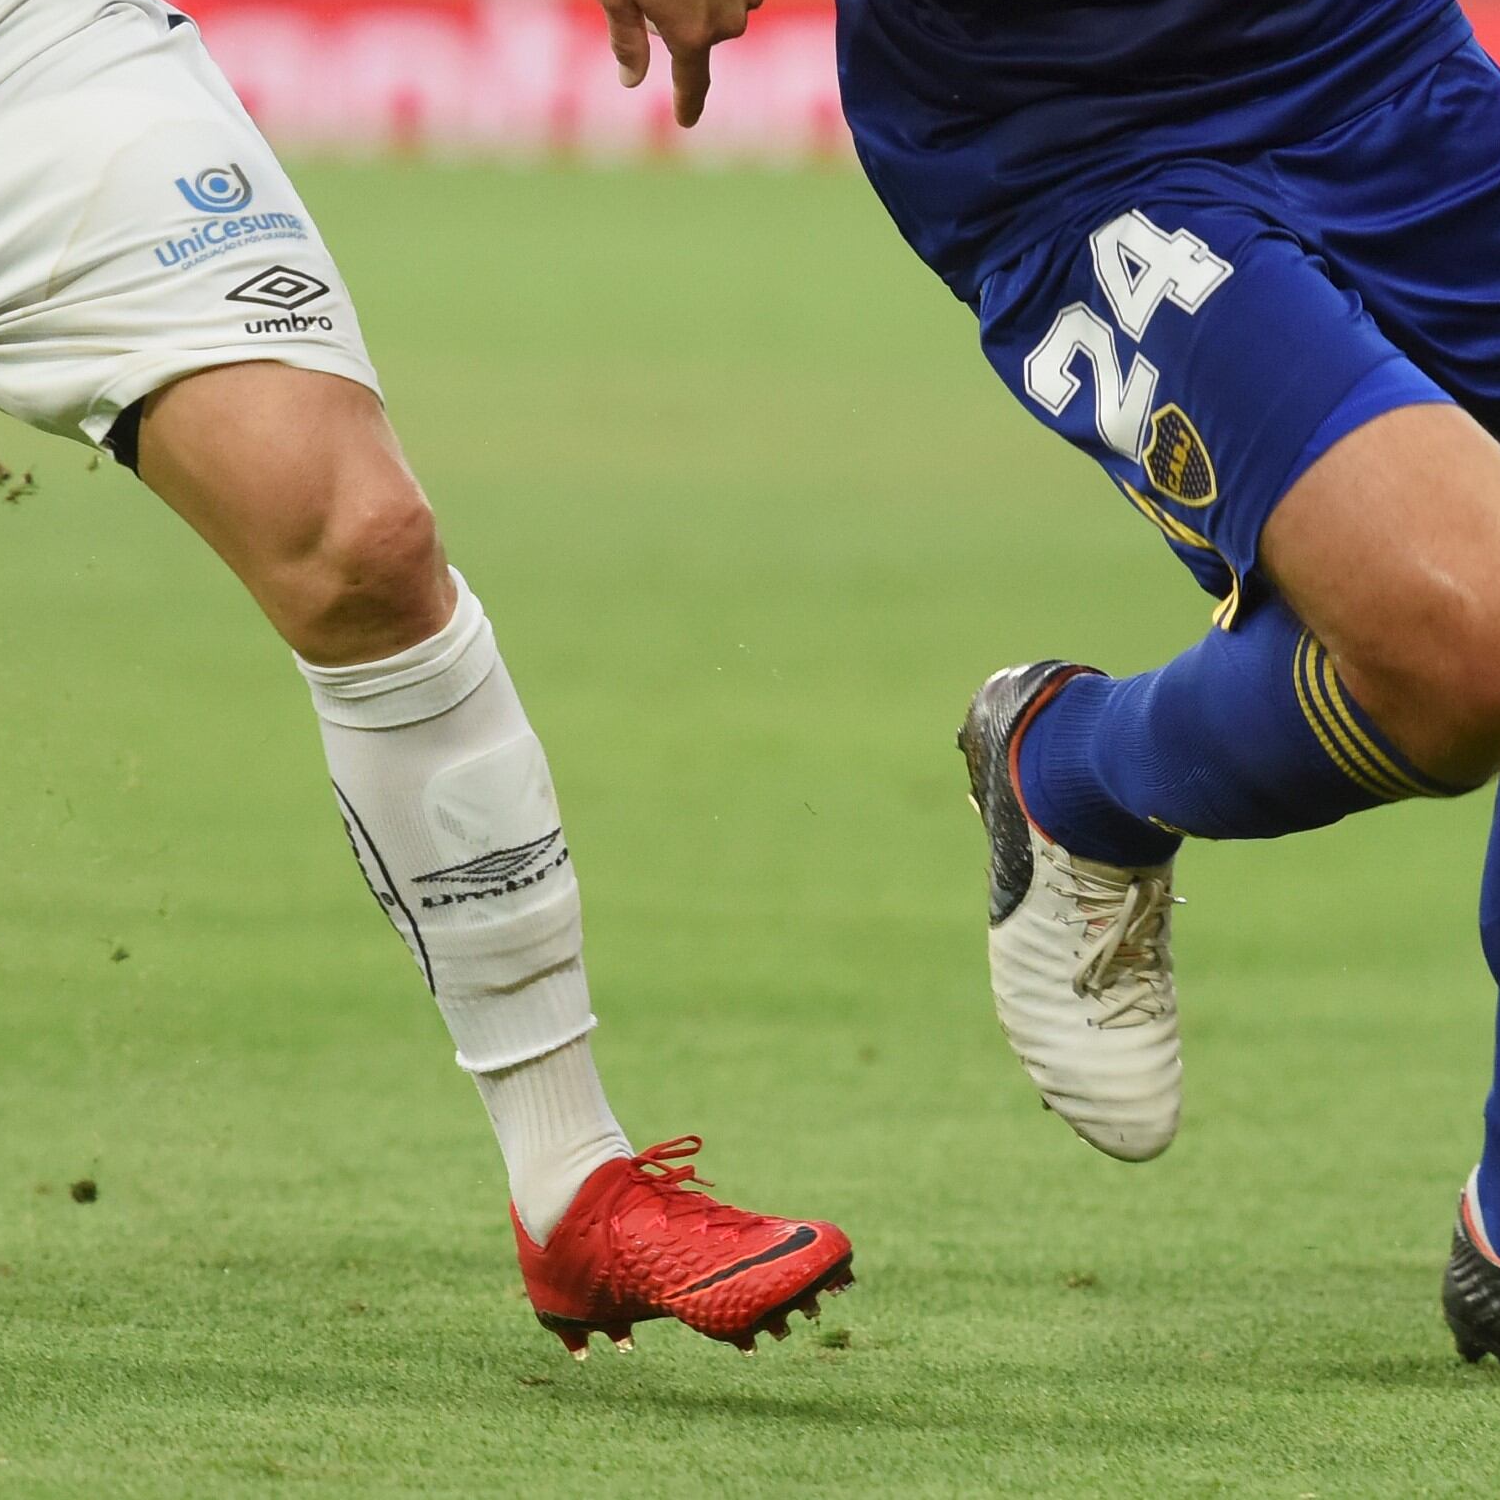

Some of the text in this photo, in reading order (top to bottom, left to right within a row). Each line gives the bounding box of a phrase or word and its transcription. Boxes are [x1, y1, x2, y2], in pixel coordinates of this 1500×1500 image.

[244, 312, 333, 334] umbro
[1023, 208, 1234, 464] 24
[1168, 429, 1192, 494] CABJ
